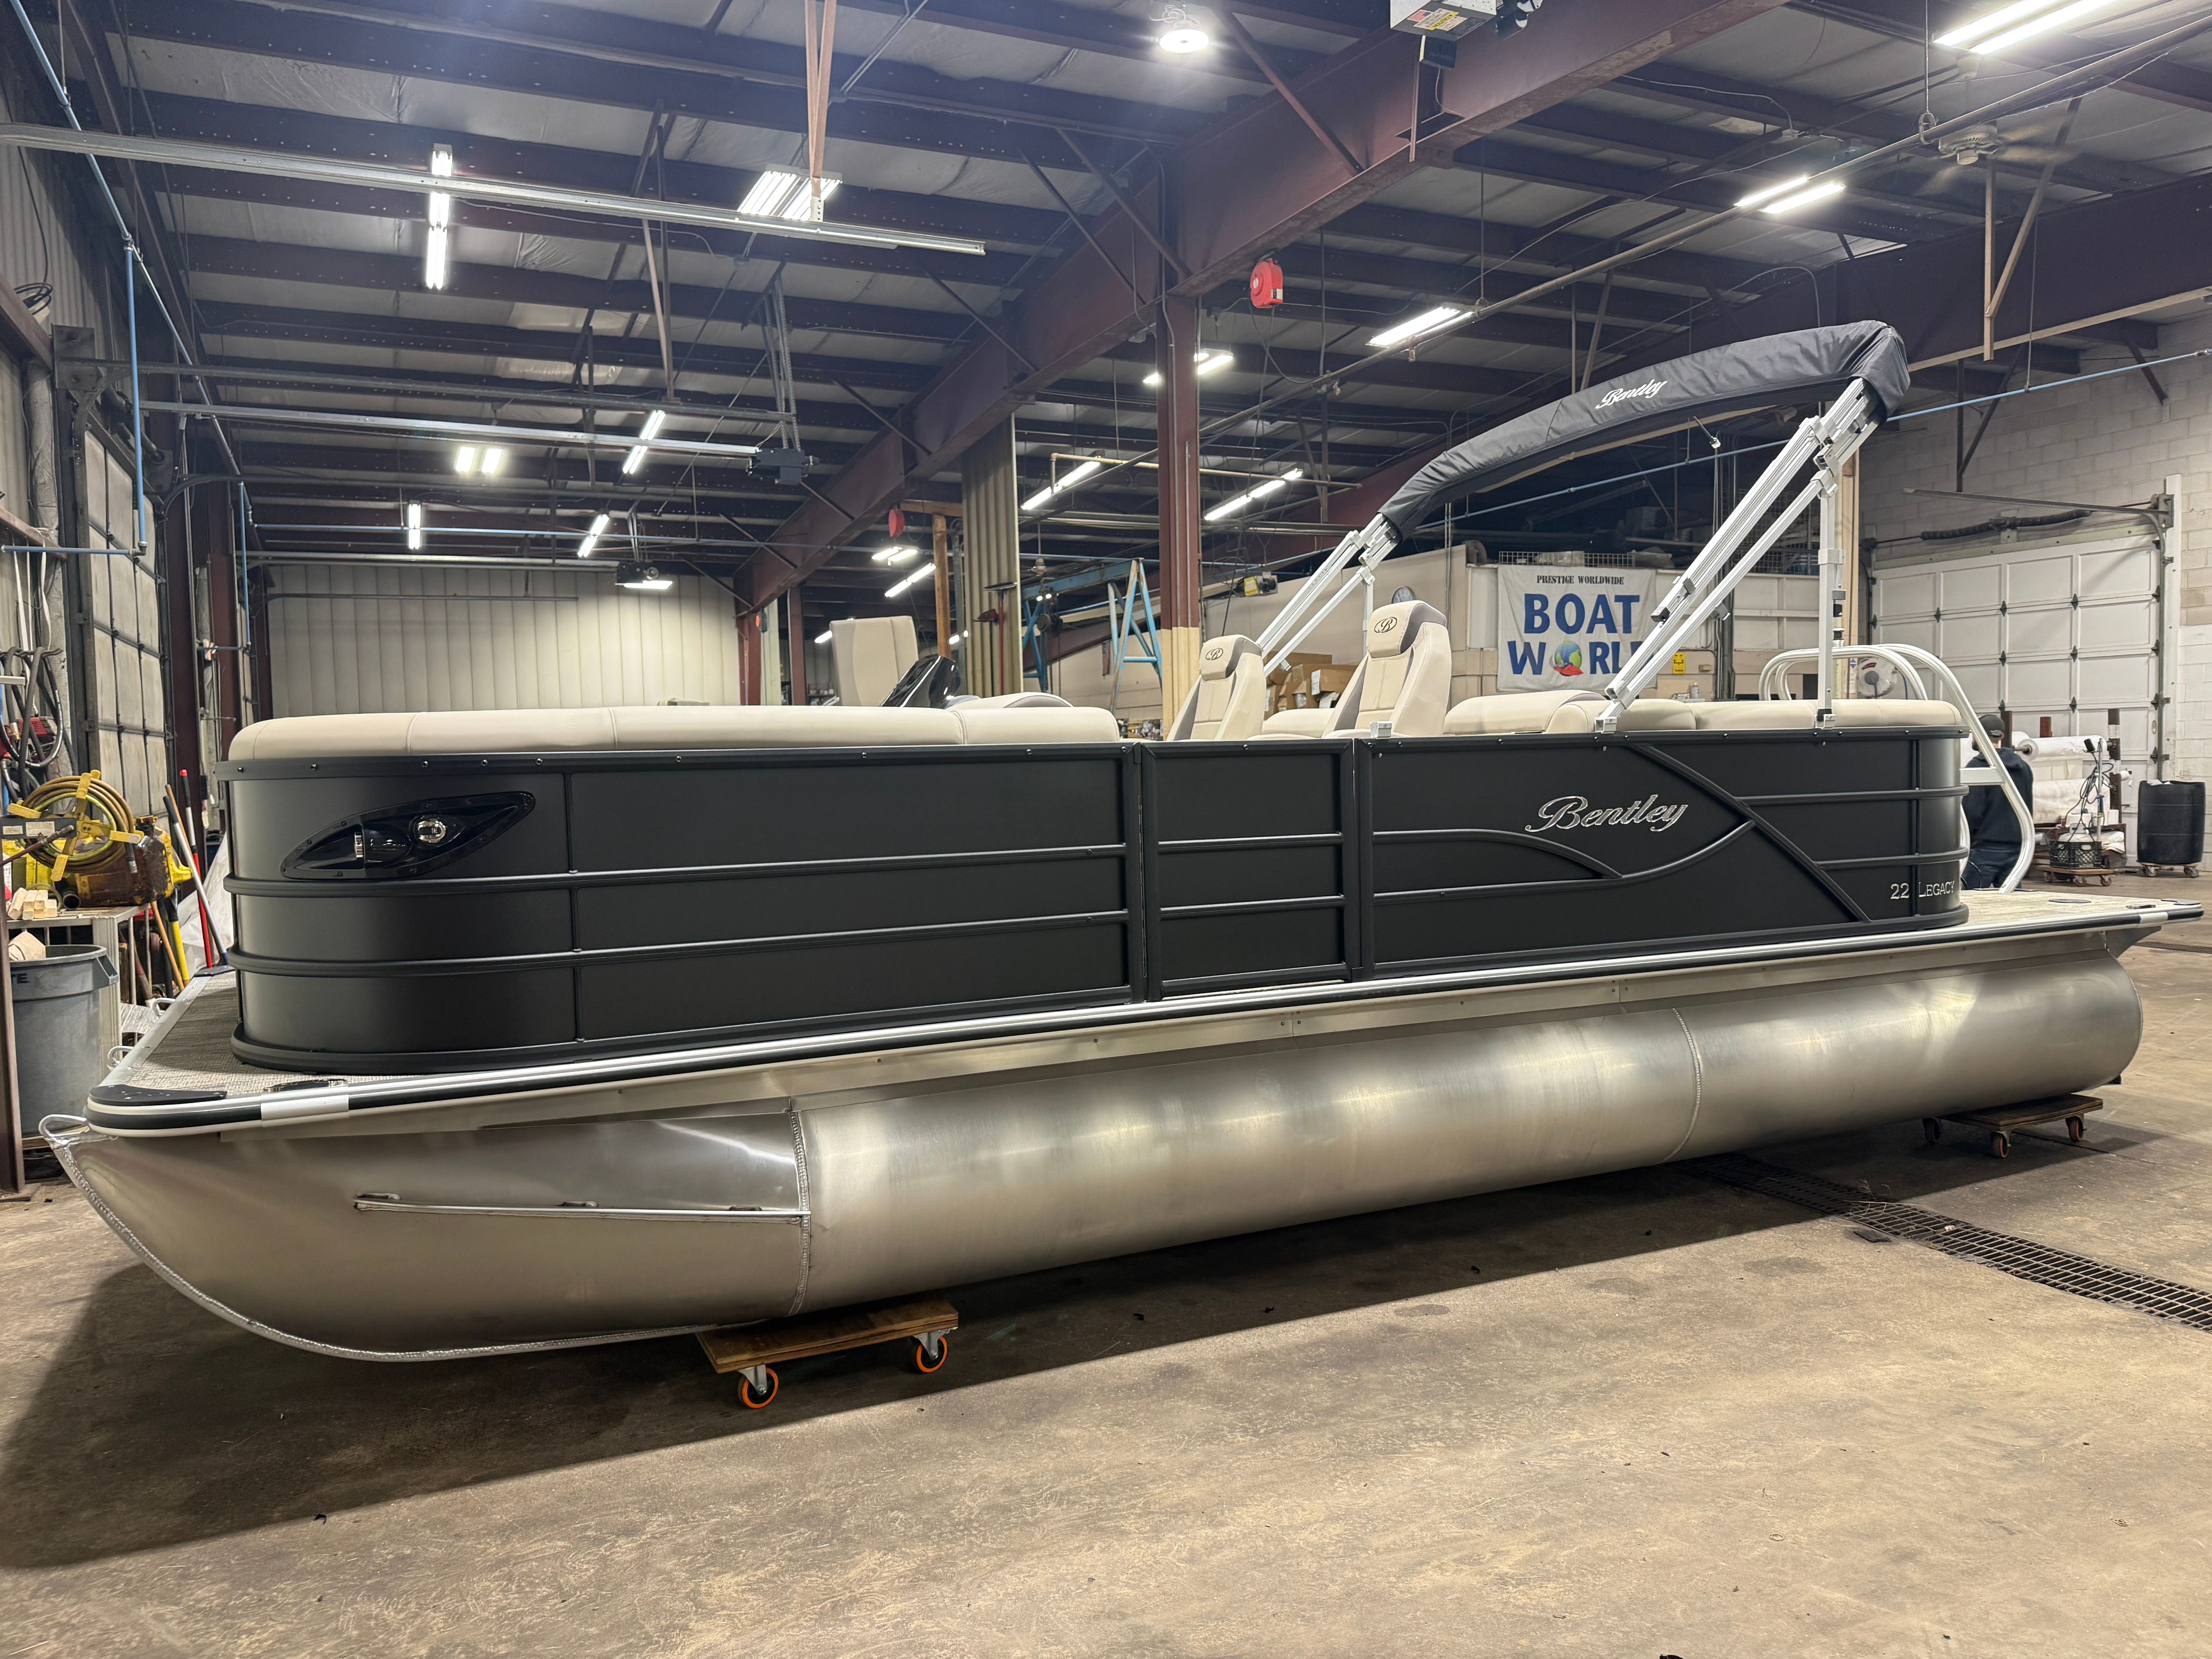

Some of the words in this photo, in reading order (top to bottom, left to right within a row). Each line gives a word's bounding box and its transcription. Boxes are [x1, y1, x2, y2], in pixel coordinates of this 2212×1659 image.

[1595, 379, 1668, 409] Bentley
[1537, 575, 1574, 584] PRESTIGE
[1578, 575, 1624, 585] WORLDWIDE
[1524, 593, 1640, 634] BOAT
[1524, 794, 1688, 832] Bentley
[1890, 883, 1910, 899] 22
[1918, 881, 1954, 897] LEGACY
